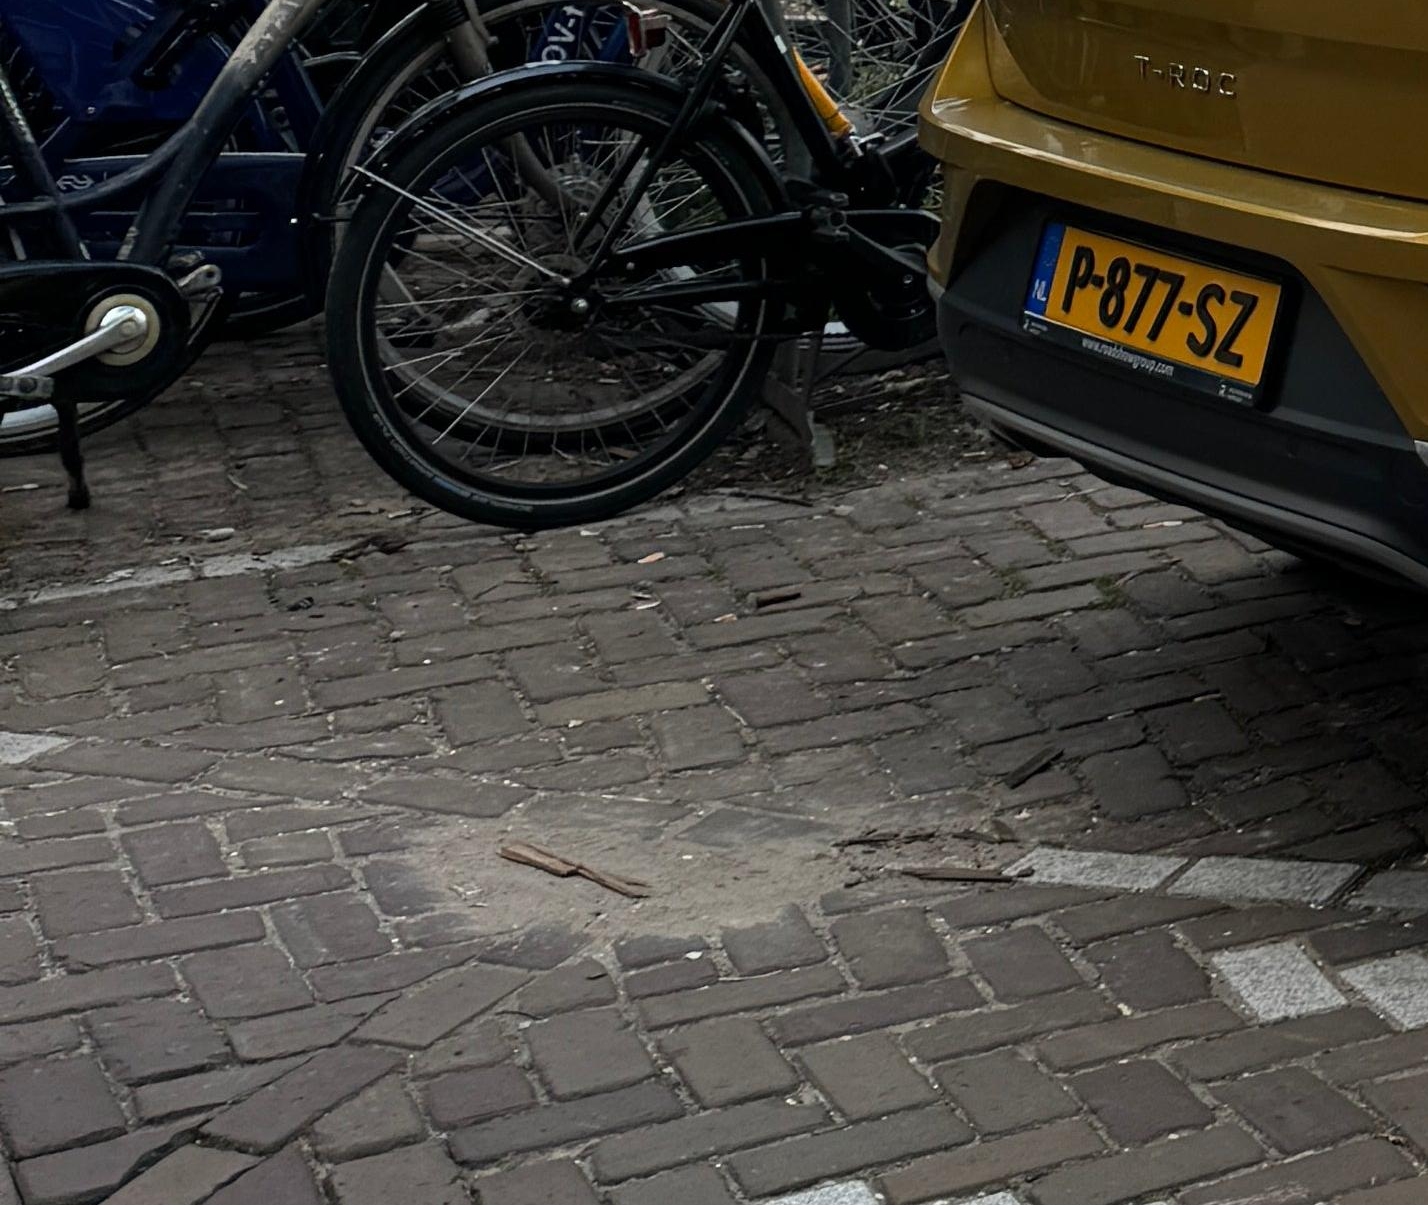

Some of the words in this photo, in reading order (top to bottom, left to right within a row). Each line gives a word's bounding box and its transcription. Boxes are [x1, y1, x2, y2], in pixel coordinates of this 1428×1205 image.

[1134, 54, 1236, 96] T-ROC
[1032, 277, 1048, 301] NL
[1061, 245, 1259, 368] P-877-SZ
